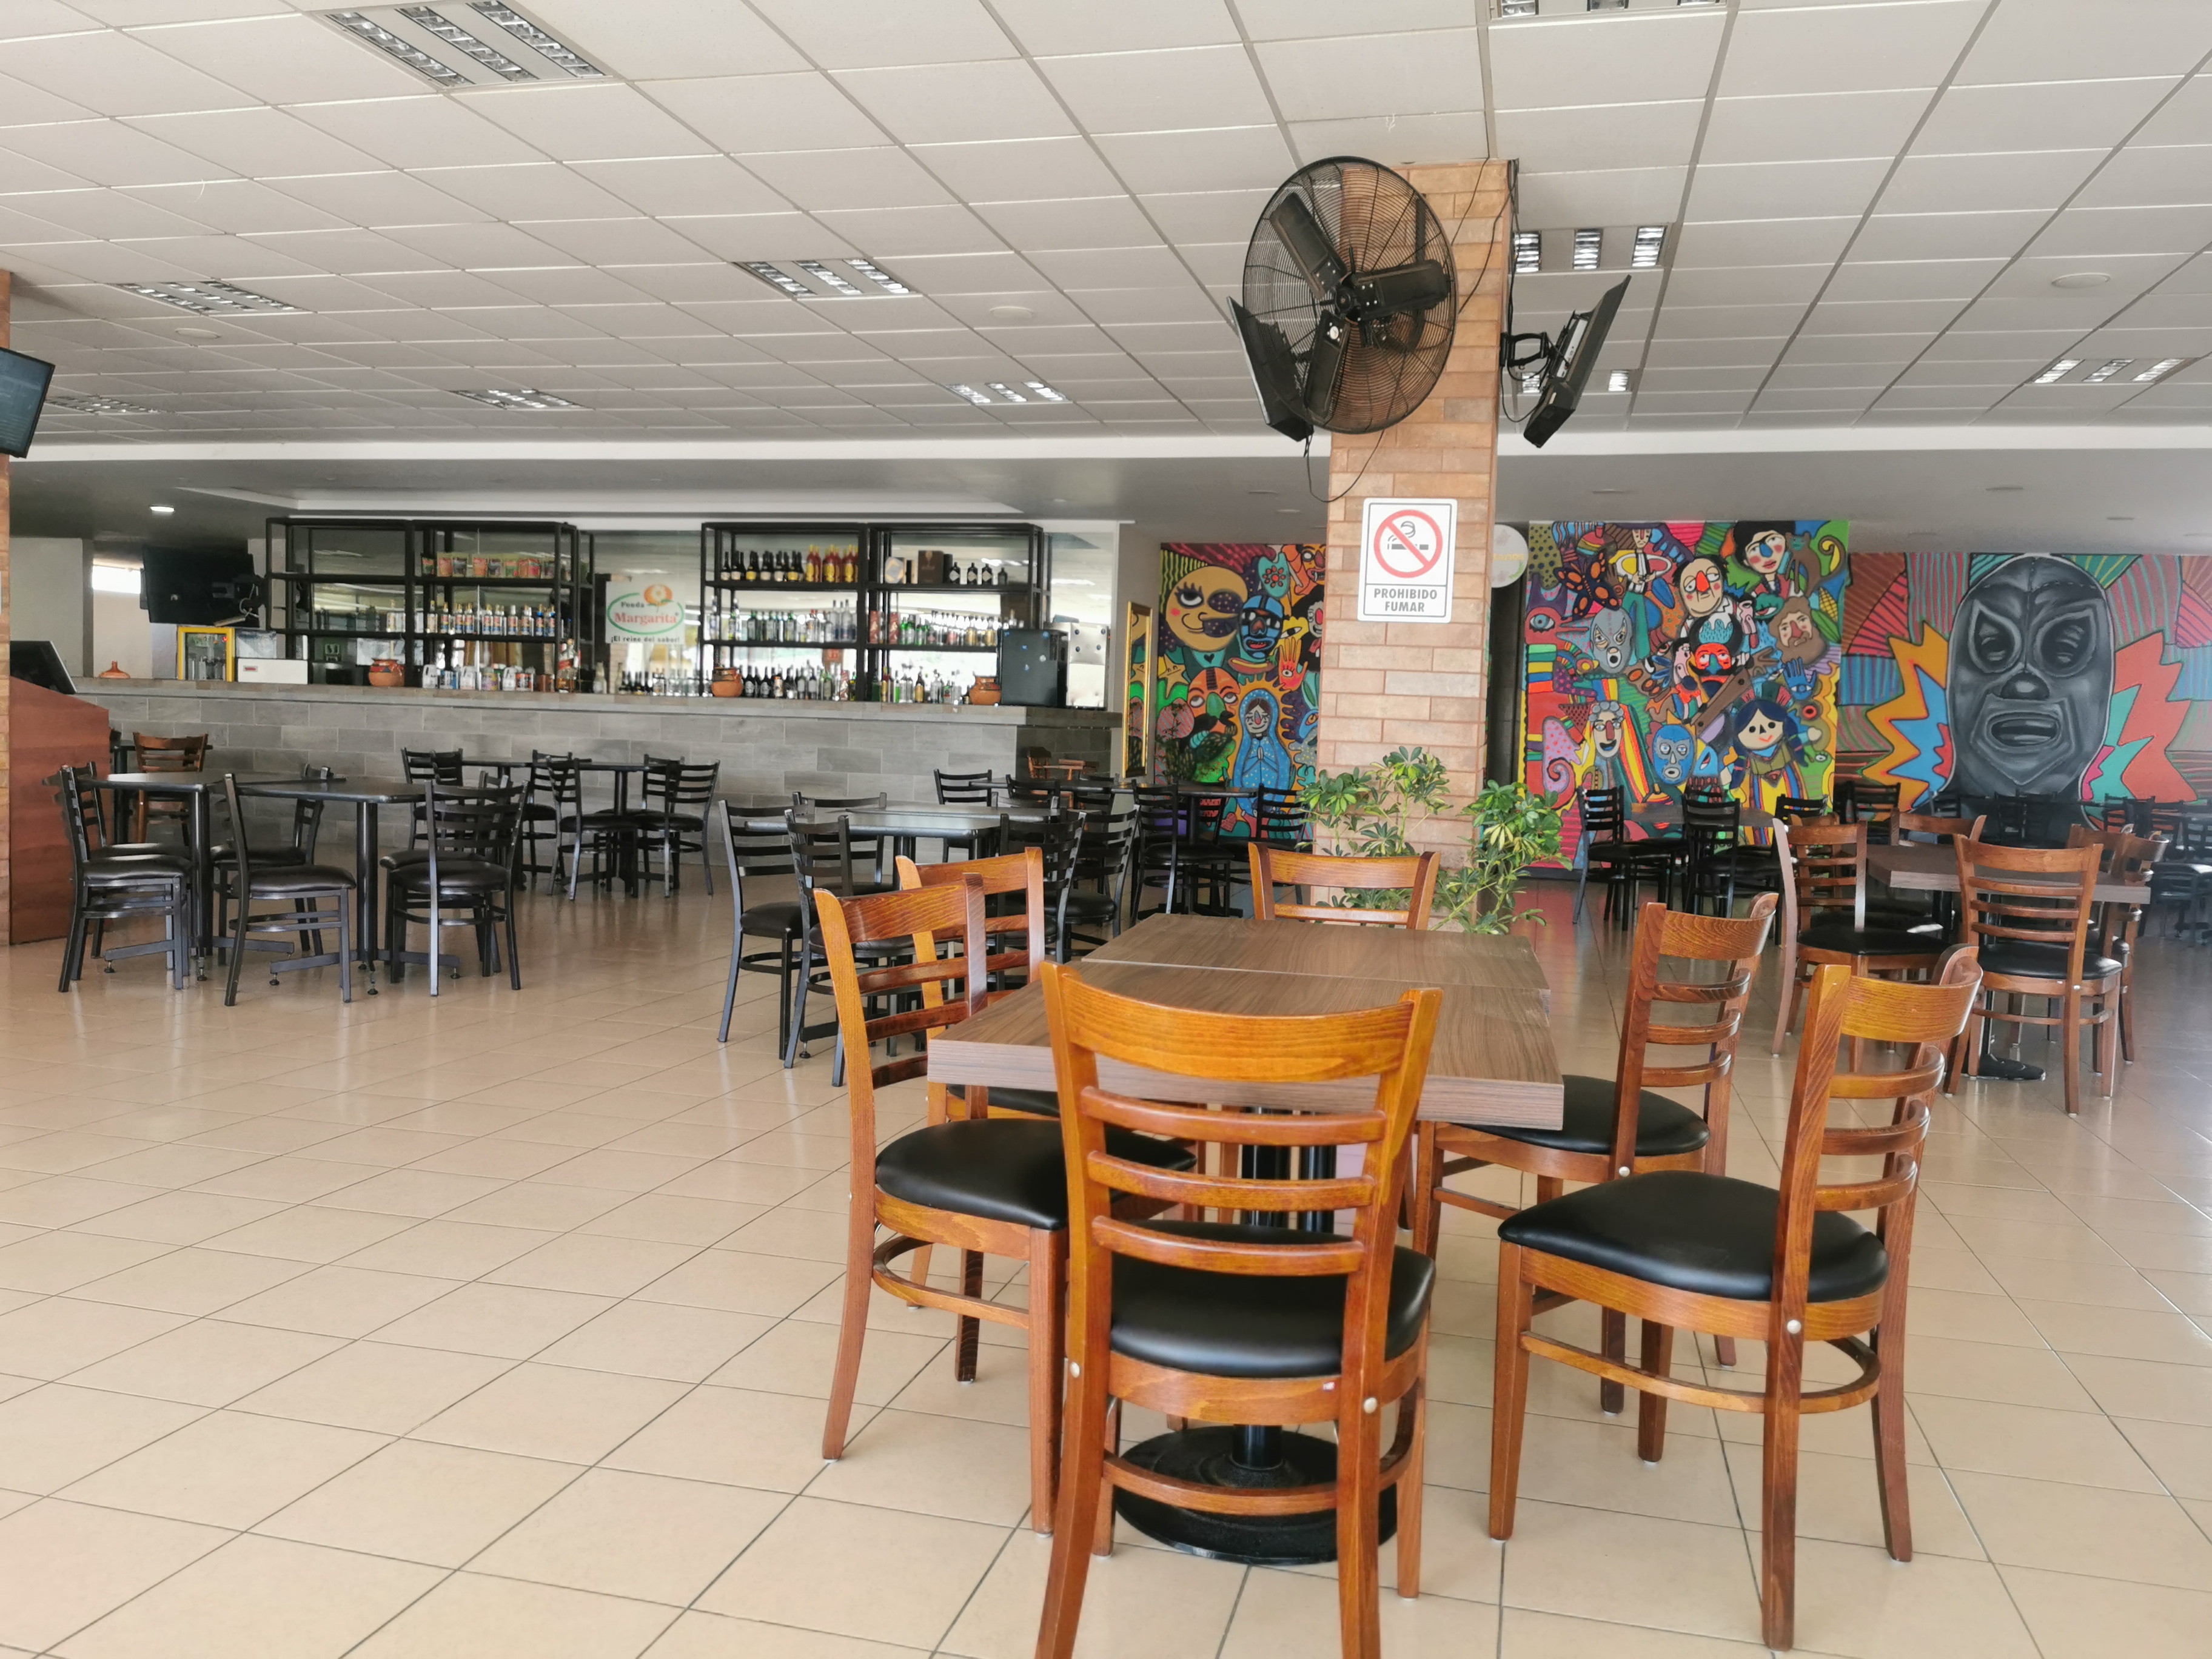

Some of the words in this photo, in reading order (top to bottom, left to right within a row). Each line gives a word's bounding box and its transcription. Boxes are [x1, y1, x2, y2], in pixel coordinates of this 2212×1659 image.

[1374, 588, 1437, 600] PROHIBIDO
[1385, 601, 1425, 612] FUMAR
[614, 613, 677, 625] Margarita
